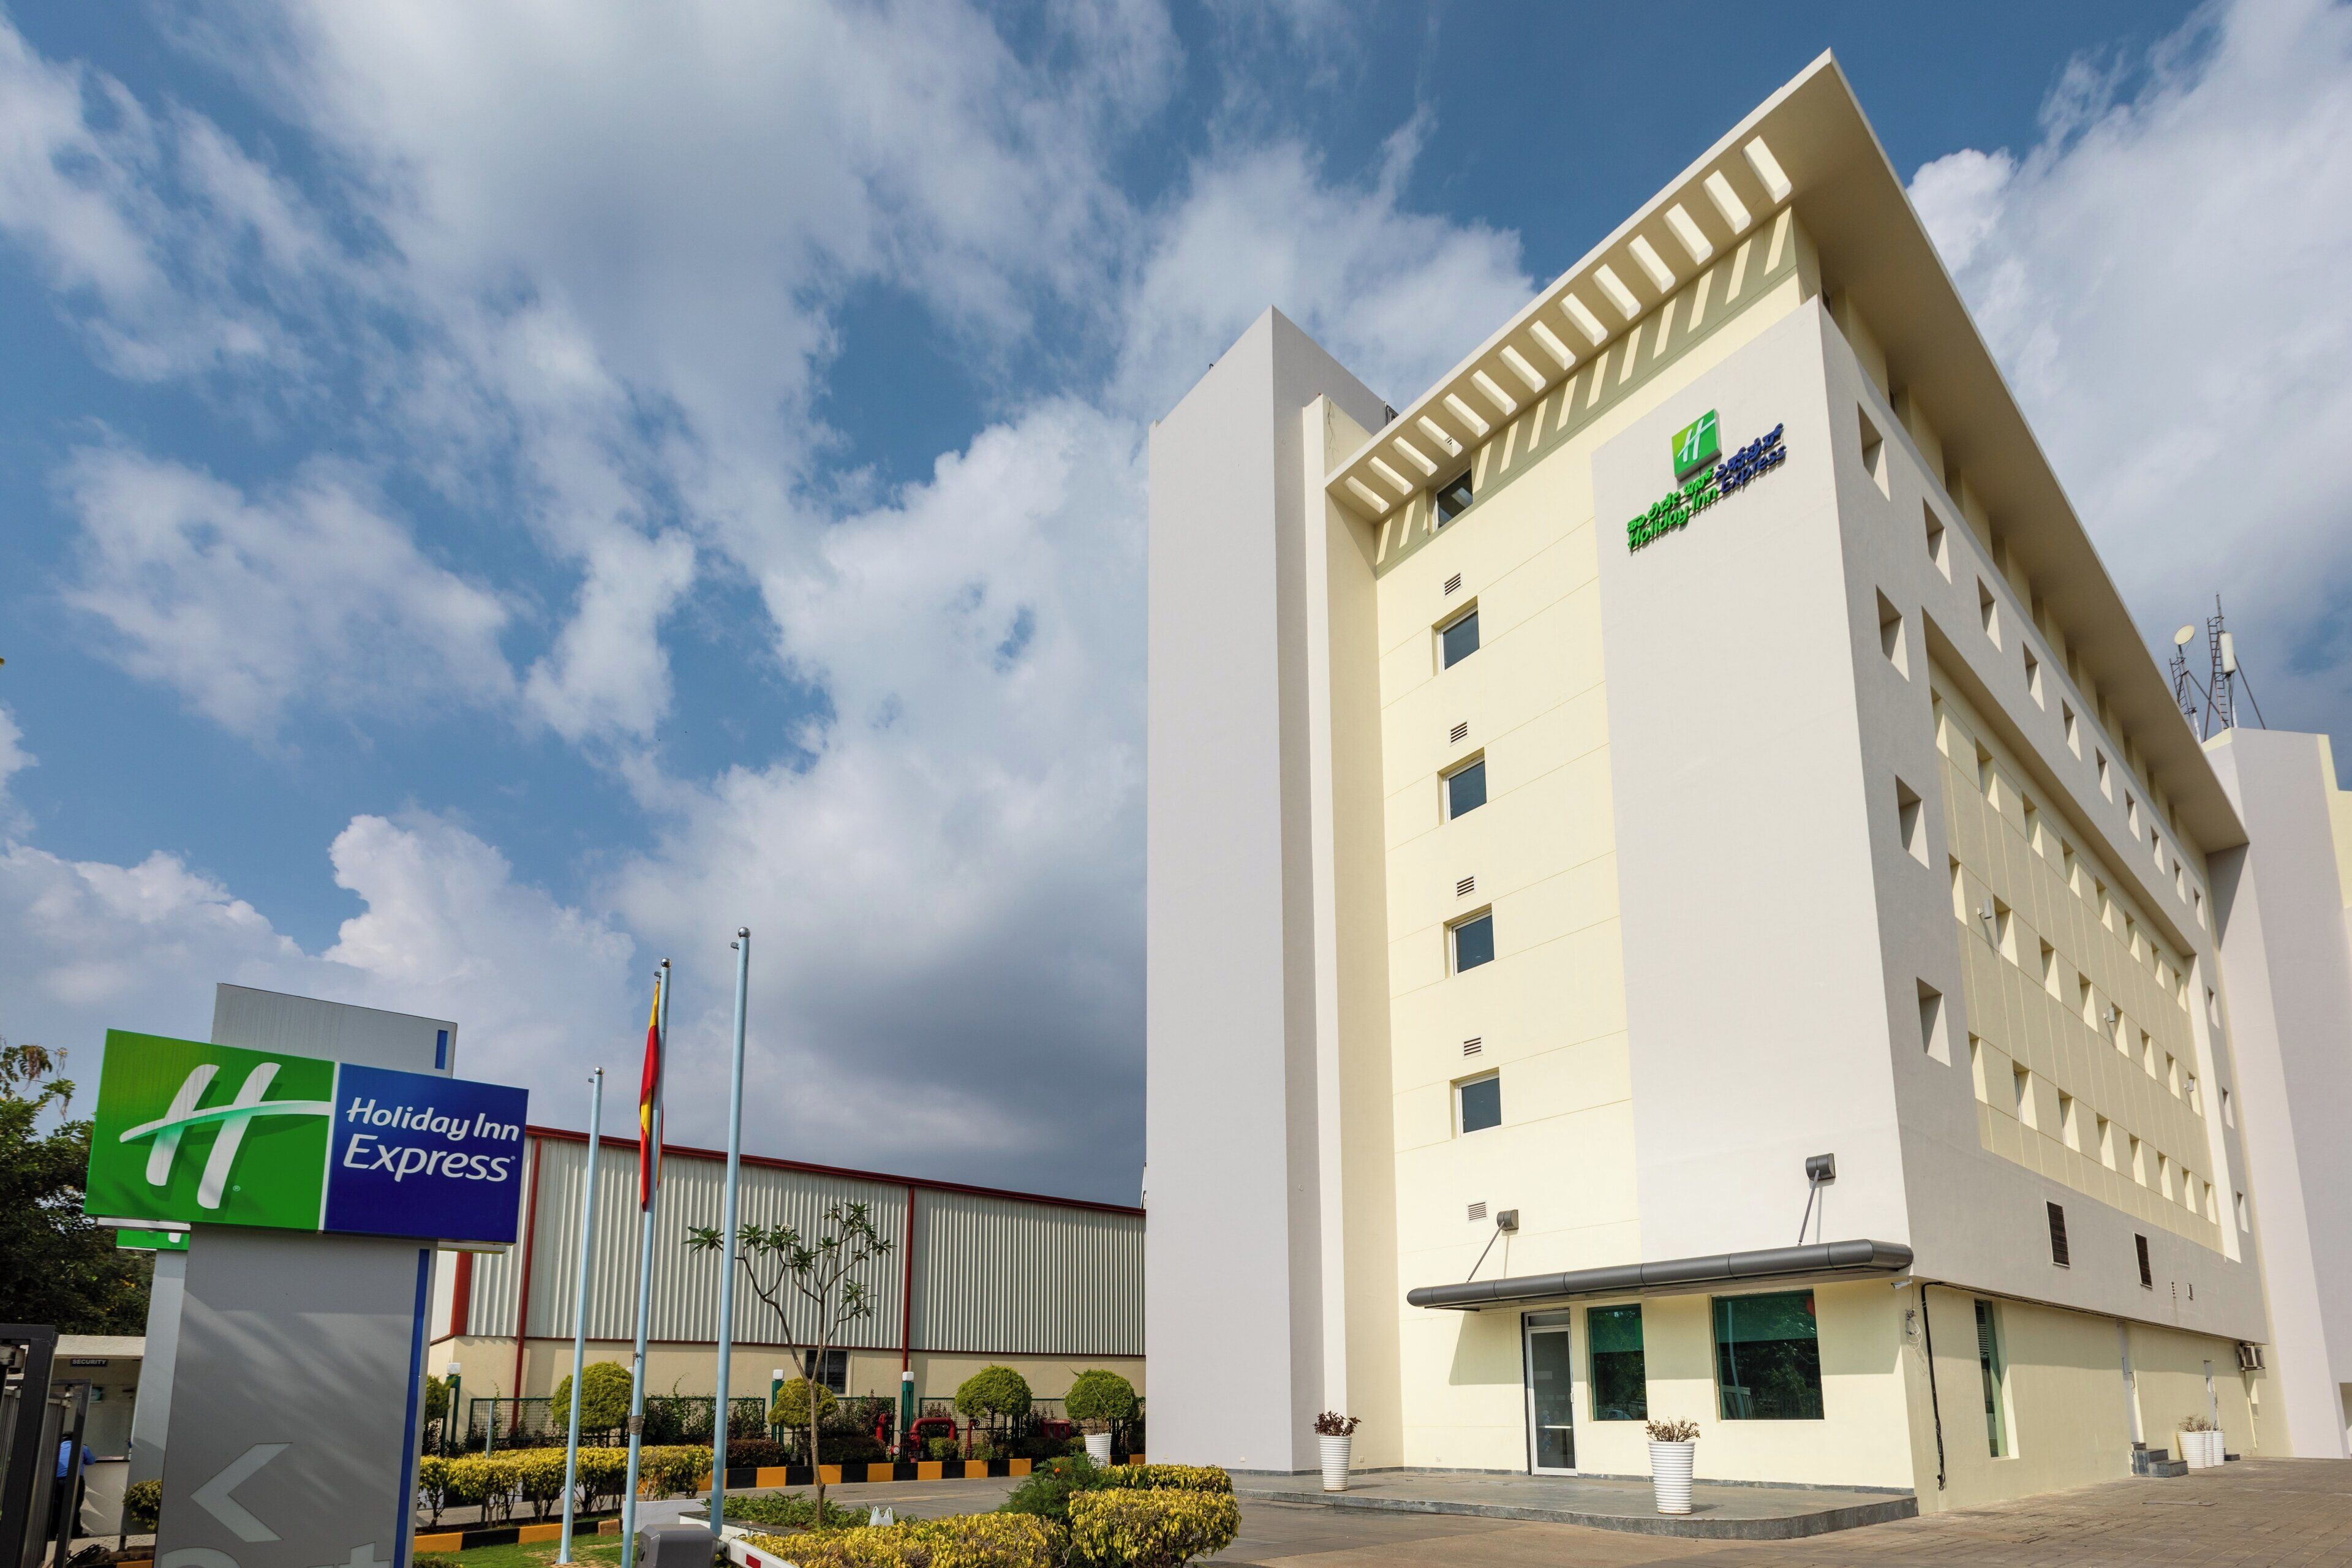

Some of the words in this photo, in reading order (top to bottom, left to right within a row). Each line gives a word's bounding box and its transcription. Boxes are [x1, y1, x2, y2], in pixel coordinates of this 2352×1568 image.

[1628, 505, 1690, 549] Holiday
[1692, 488, 1718, 511] Inn
[1721, 445, 1786, 493] Express
[346, 1097, 470, 1141] Holiday
[473, 1113, 519, 1141] Inn
[343, 1133, 510, 1182] Express
